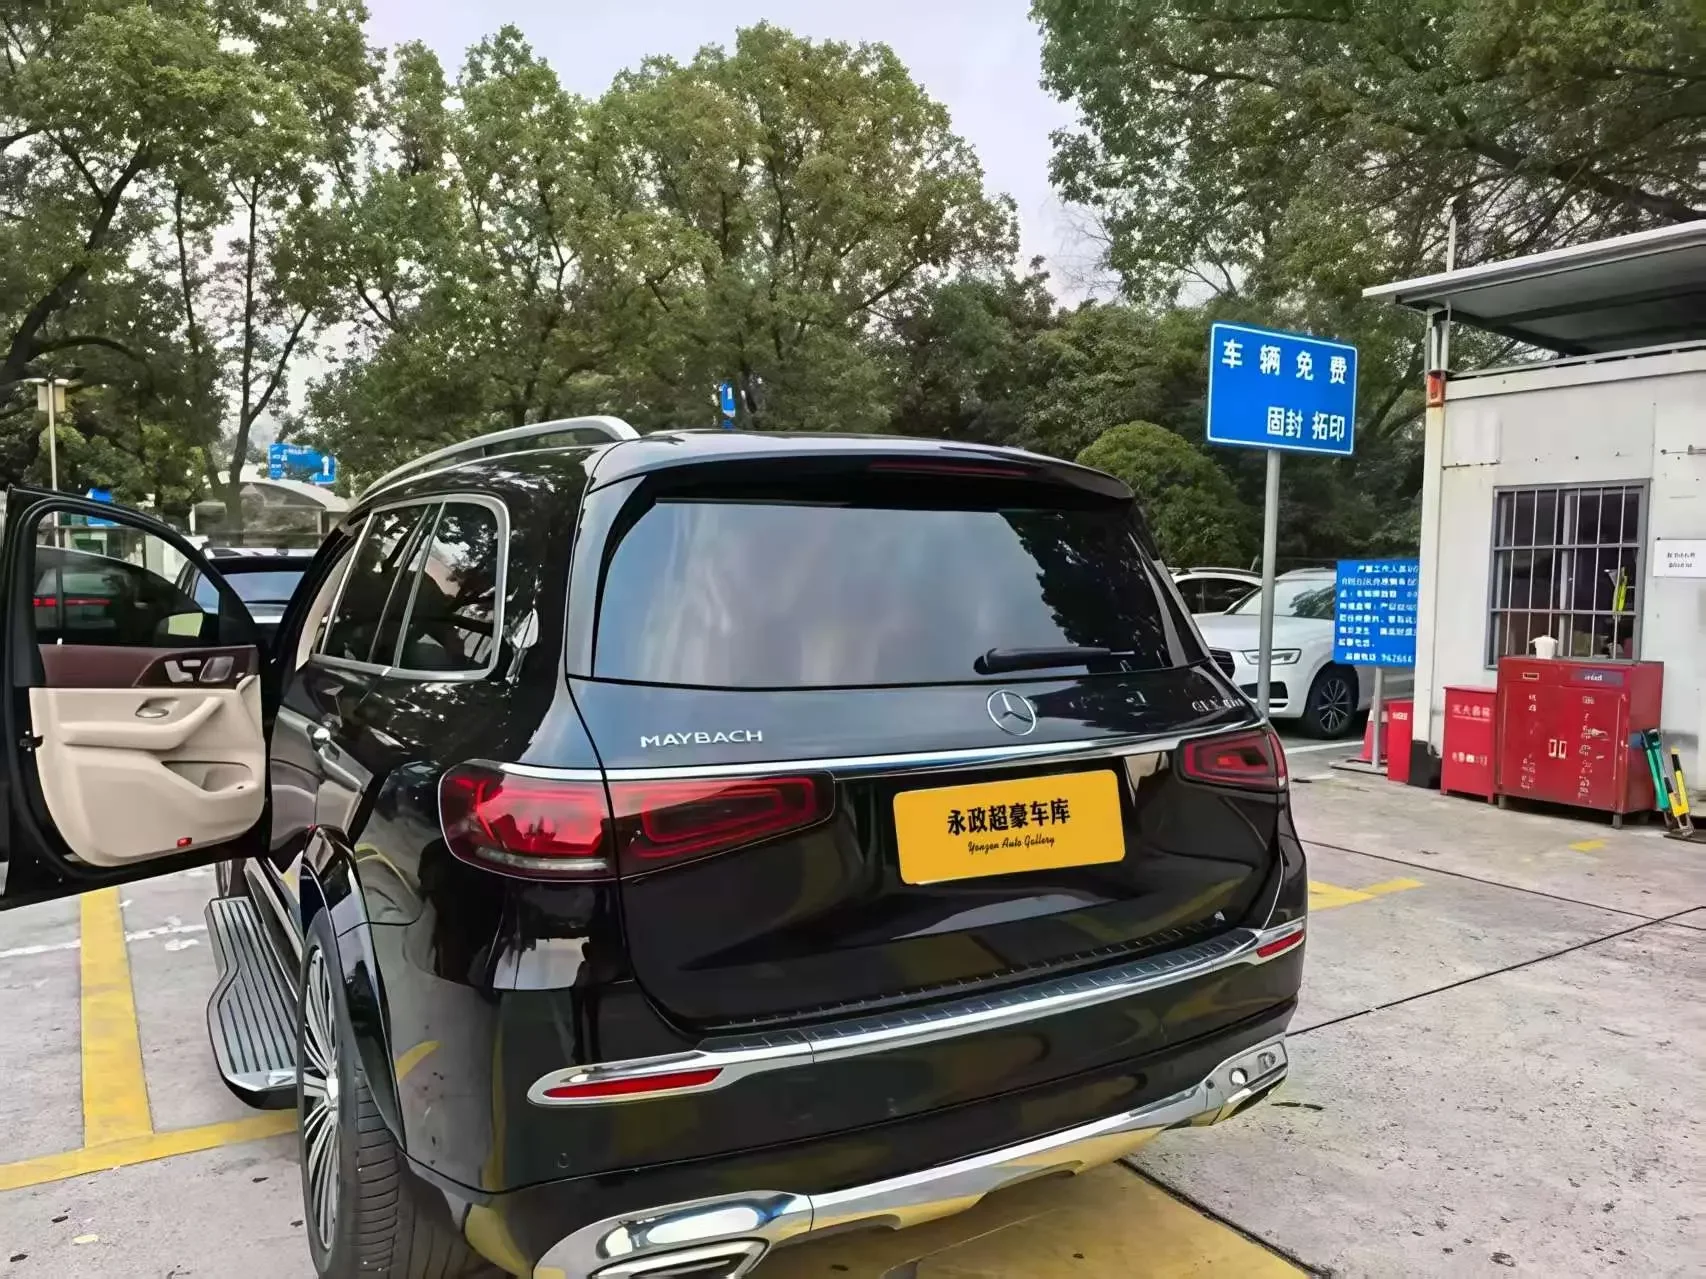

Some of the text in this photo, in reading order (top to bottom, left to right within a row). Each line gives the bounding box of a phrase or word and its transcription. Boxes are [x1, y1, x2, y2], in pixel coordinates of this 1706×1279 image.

[1222, 339, 1347, 384] 车辆免费
[1267, 406, 1345, 442] 固封 拓印
[640, 730, 763, 748] MAYBACH
[947, 798, 1071, 836] 永政超豪车库
[1001, 837, 1022, 849] Auto
[1024, 833, 1055, 849] Gallery
